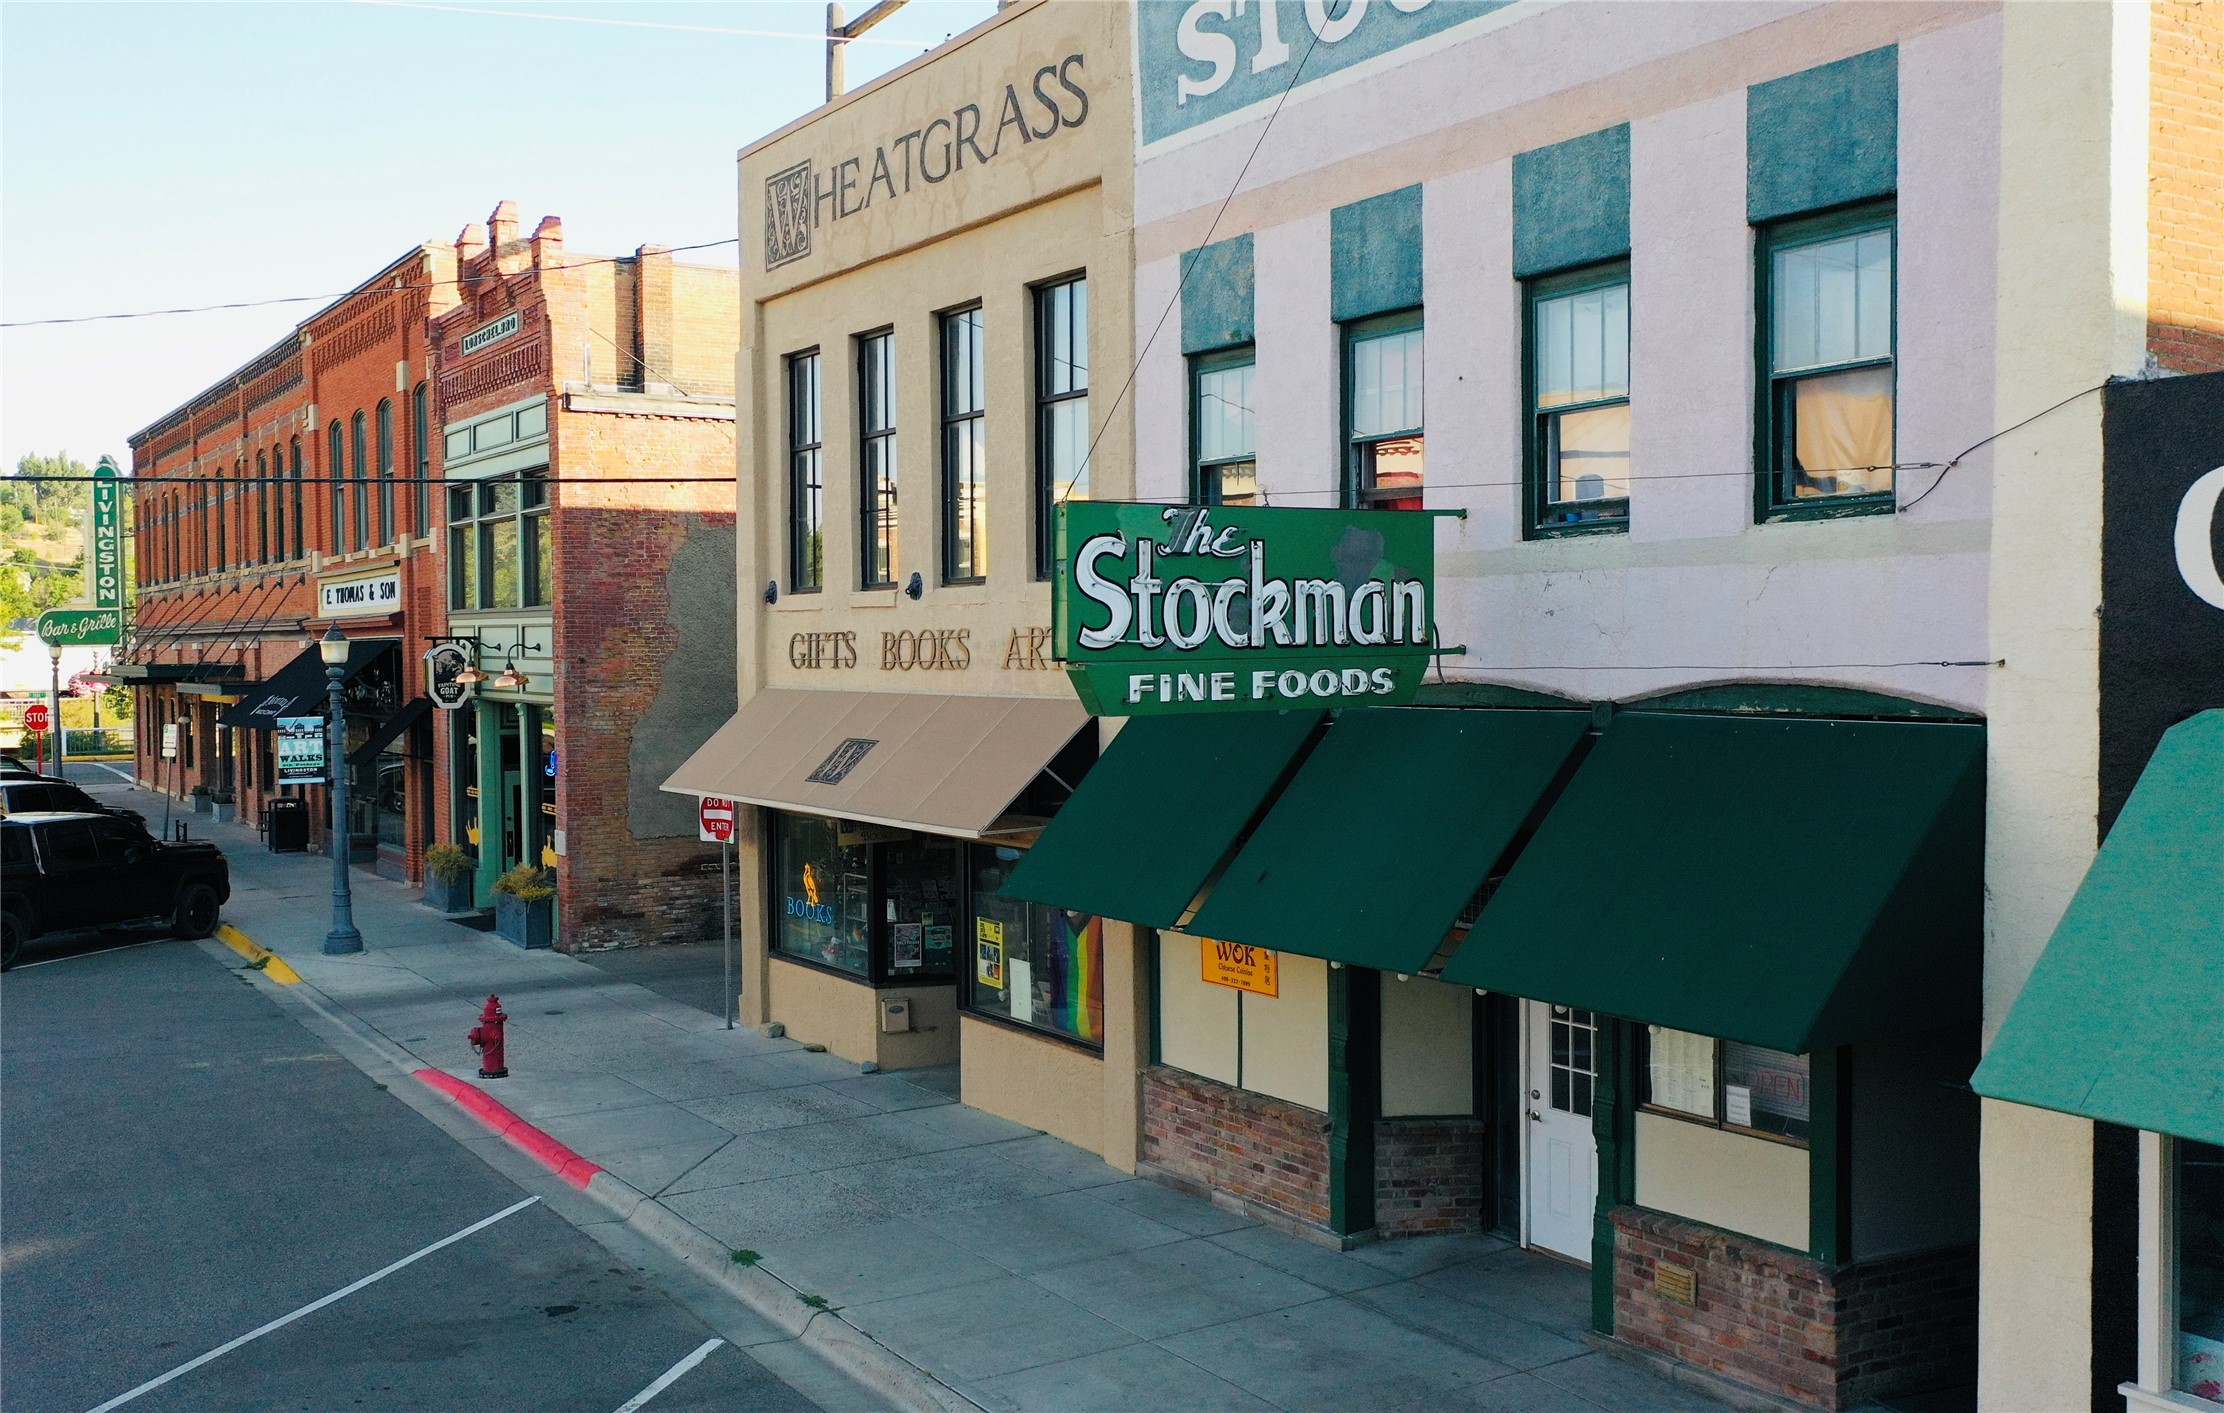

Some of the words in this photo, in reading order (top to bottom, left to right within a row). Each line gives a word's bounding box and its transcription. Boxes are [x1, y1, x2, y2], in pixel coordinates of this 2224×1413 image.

[765, 54, 1089, 272] WHEATGRASS
[97, 480, 116, 600] LIVINGSTON
[1157, 507, 1248, 556] The
[335, 585, 365, 604] THOMAS
[368, 584, 375, 600] &
[380, 581, 396, 600] SON
[1075, 532, 1428, 649] Stockman
[41, 619, 70, 637] Bar
[70, 623, 78, 633] &
[77, 613, 117, 639] Grille
[788, 630, 857, 670] GIFTS
[879, 628, 970, 671] BOOKS
[440, 687, 459, 695] GOAT
[1129, 671, 1236, 703] FINE
[1252, 668, 1396, 699] FOODS
[280, 740, 323, 755] ART
[280, 754, 323, 763] WALKS
[707, 798, 719, 807] DO
[787, 896, 832, 924] BOOKS
[1216, 941, 1256, 967] WOK
[1742, 1069, 1800, 1101] OPEN
